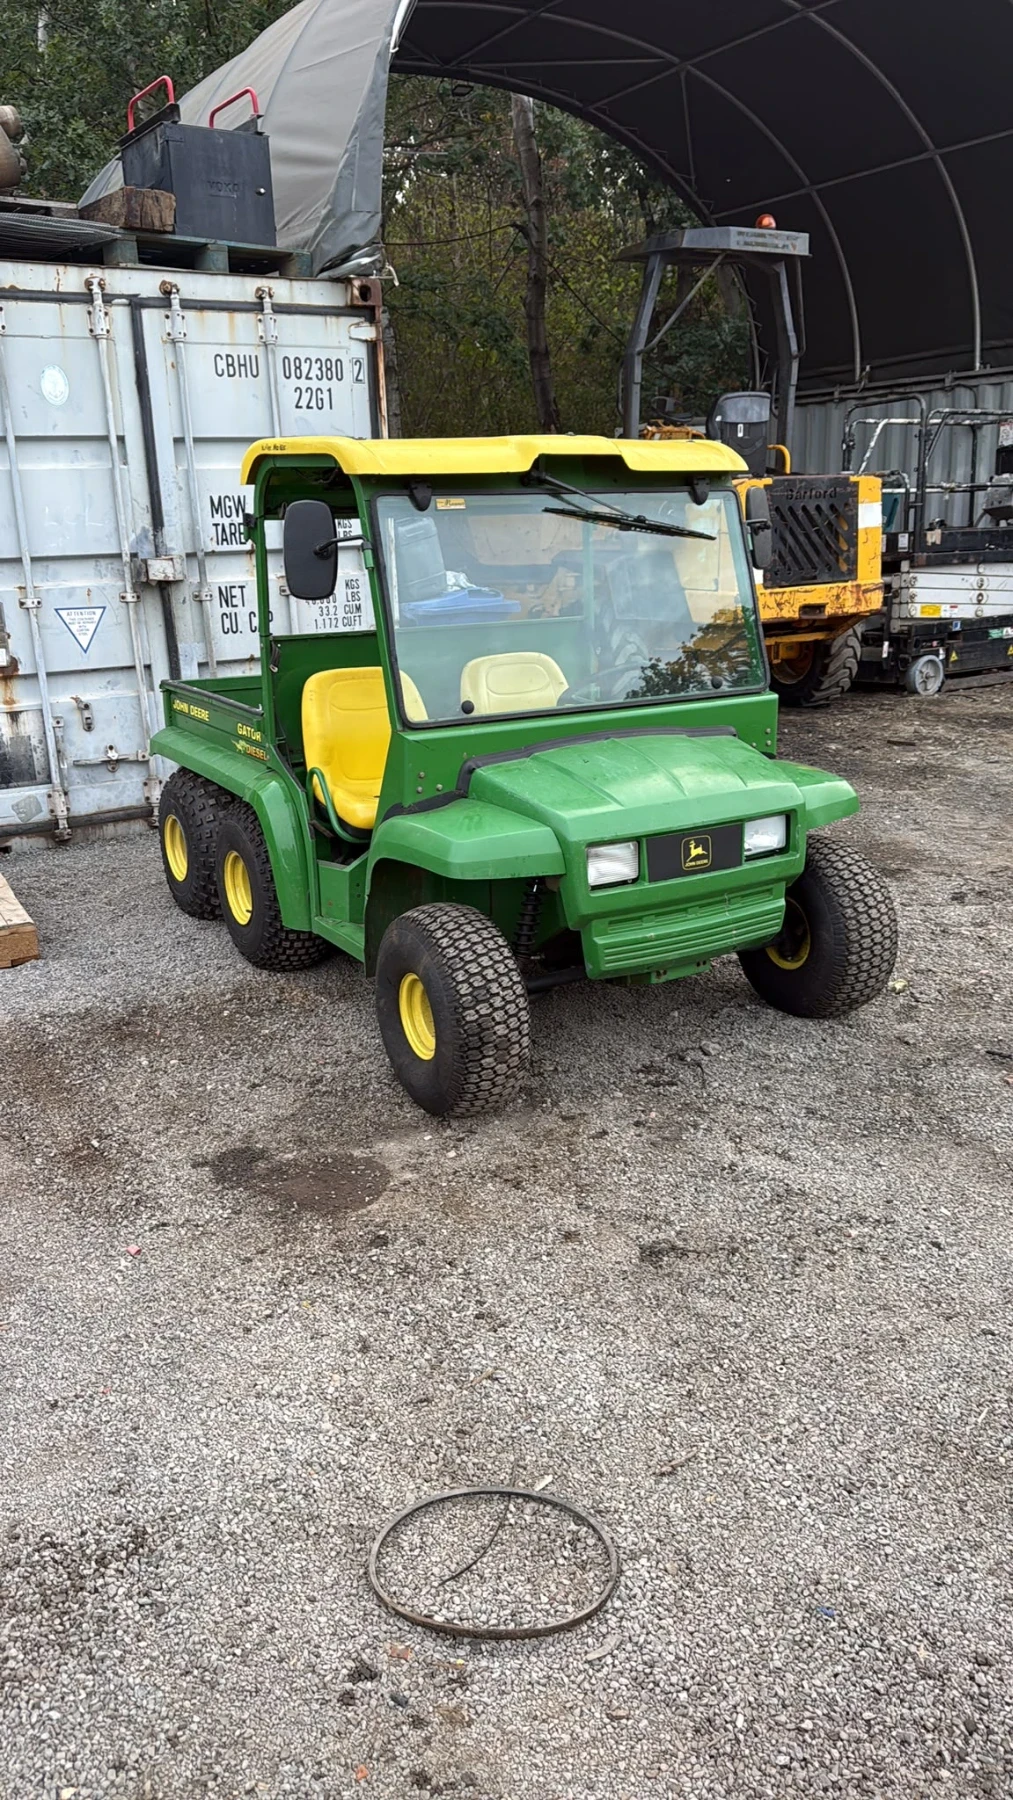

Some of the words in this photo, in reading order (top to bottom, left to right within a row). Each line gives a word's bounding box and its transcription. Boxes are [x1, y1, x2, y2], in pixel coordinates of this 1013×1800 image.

[214, 354, 259, 378] CBHU
[282, 356, 344, 381] 082380
[354, 359, 363, 382] 2
[294, 387, 333, 410] 22G1
[209, 495, 245, 518] MGW
[212, 523, 246, 545] TARE
[345, 579, 360, 590] KGS
[218, 585, 245, 608] NET
[346, 591, 361, 602] LBS
[319, 605, 338, 617] 33.2
[221, 612, 243, 634] CU.
[315, 618, 339, 629] 1.172
[173, 700, 189, 713] JOHN
[190, 705, 210, 721] DEERE
[237, 723, 261, 742] GATOR
[246, 745, 268, 760] DIESEL
